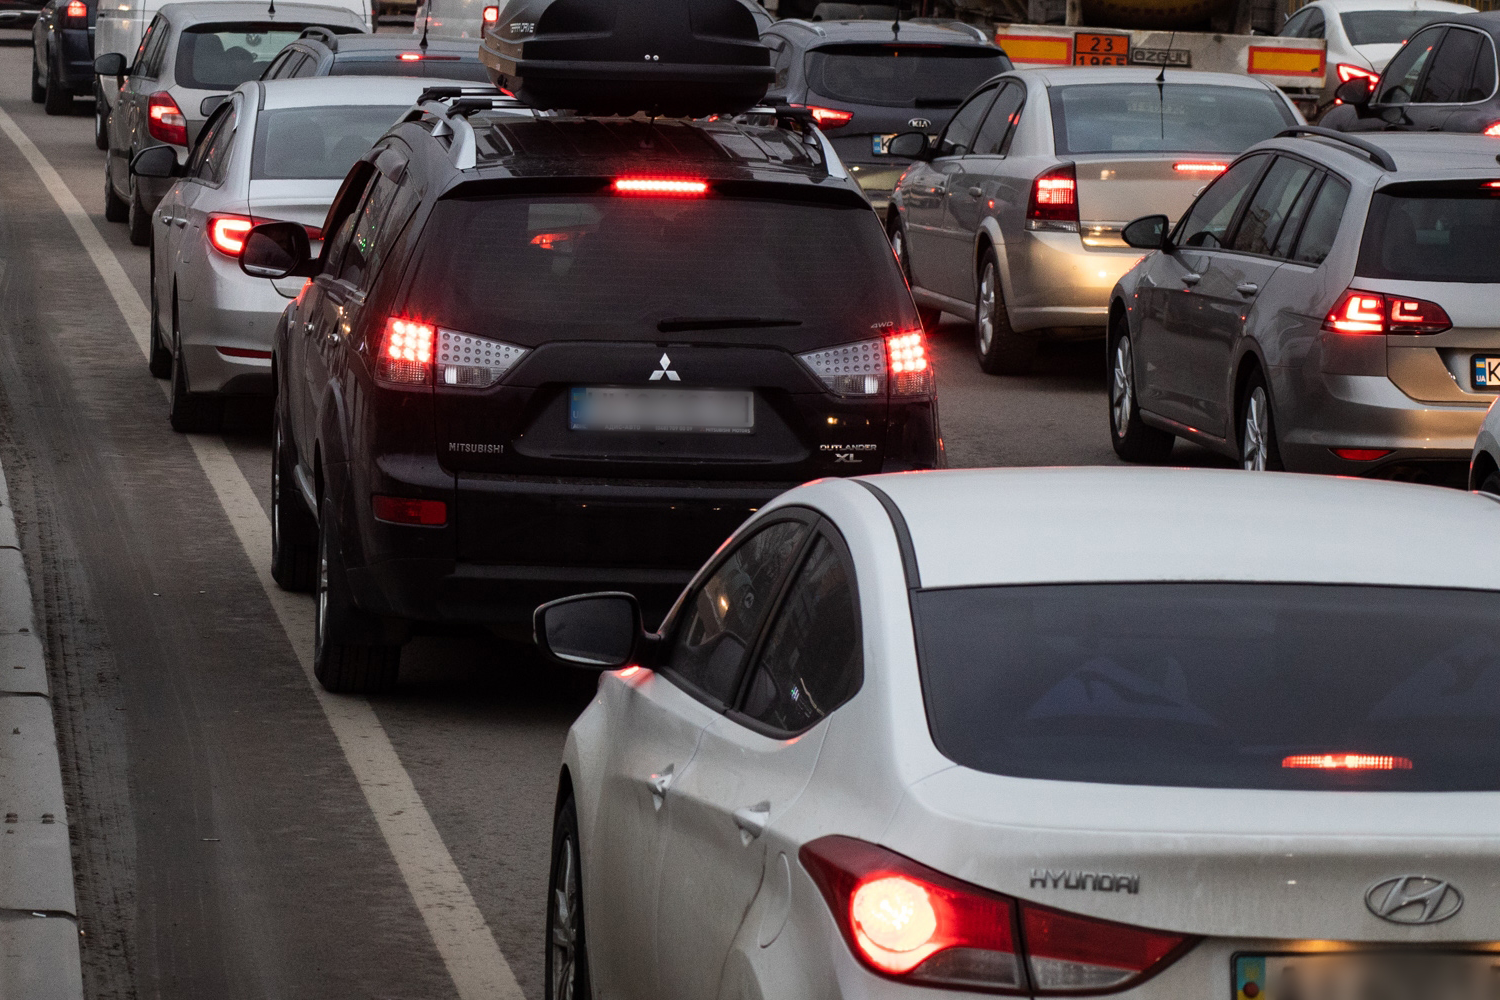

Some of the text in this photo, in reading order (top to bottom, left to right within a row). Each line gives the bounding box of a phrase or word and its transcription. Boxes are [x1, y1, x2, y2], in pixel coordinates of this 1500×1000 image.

[1090, 37, 1114, 52] 23
[911, 120, 928, 128] KIA
[870, 321, 894, 329] 4WD
[1476, 375, 1486, 383] UA
[448, 442, 504, 454] MITSUBISHI
[834, 453, 863, 463] XL
[1029, 868, 1141, 895] HYUNDAI
